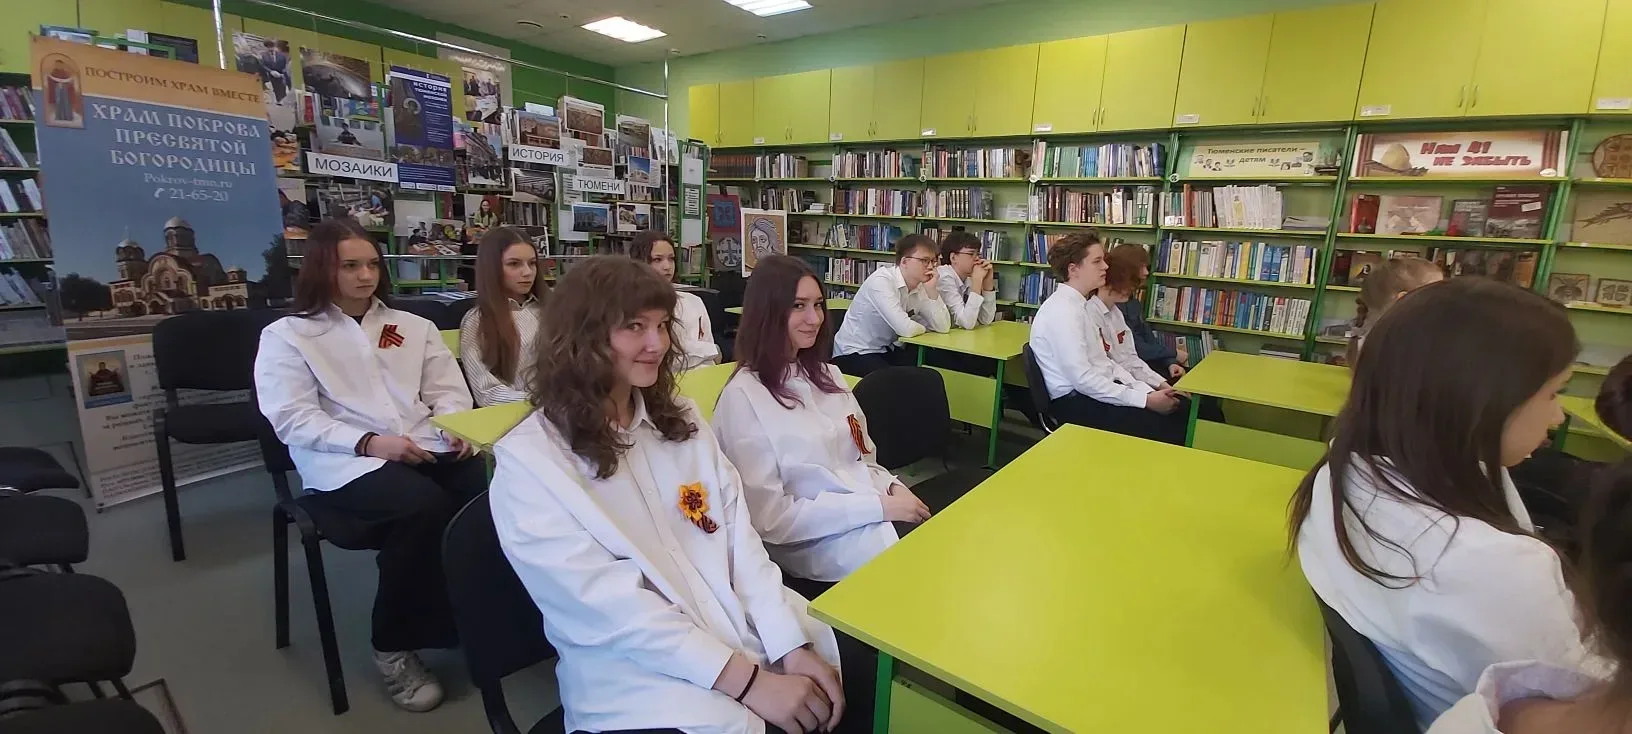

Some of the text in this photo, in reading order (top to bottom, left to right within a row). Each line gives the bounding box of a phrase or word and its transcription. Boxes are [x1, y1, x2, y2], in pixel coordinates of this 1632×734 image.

[85, 66, 260, 103] ПОСТРОИМ ХРАМ ВМЕСТЕ
[92, 103, 261, 138] ХРАМ ПОКРОВА
[115, 128, 248, 156] ПРЕСВЯТОЙ
[110, 149, 257, 176] БОГОРОДИЦЫ
[512, 147, 564, 162] ИСТОРИЯ
[315, 157, 393, 178] МОЗАИКИ
[144, 172, 233, 188] Pokrov-tmn.ru
[578, 179, 620, 191] ТЮМЕНИ
[169, 188, 229, 201] 21-65-20
